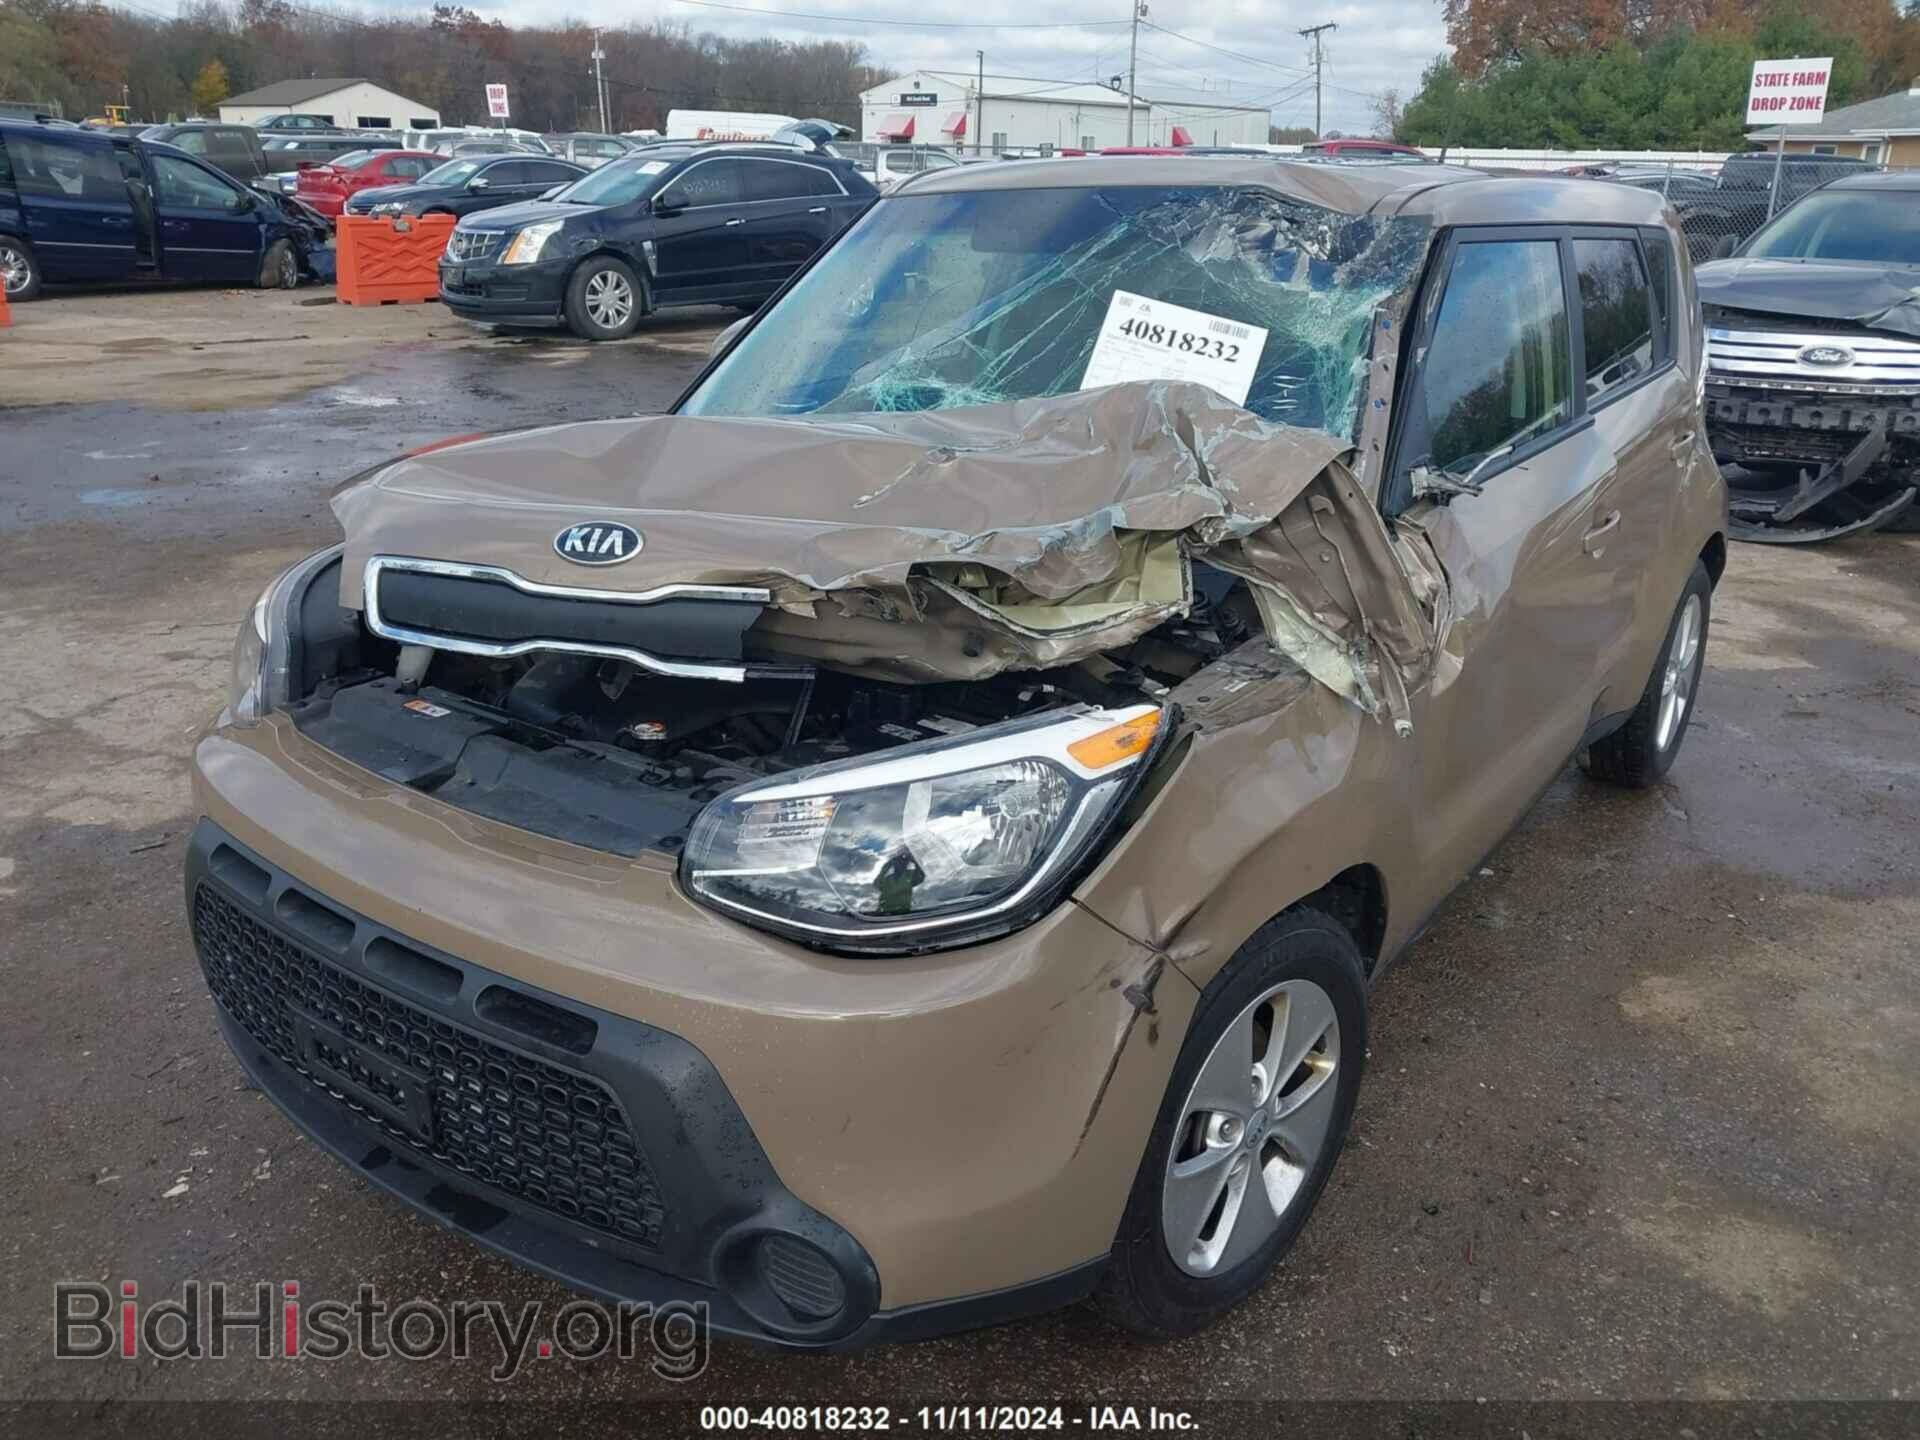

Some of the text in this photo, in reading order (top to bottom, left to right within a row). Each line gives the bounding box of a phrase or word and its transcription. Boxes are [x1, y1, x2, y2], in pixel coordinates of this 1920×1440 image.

[1755, 71, 1827, 87] STATE FARM
[1751, 96, 1822, 111] DROP ZONE
[1119, 316, 1240, 364] 40818232
[1810, 348, 1842, 362] Ford
[563, 527, 624, 556] KIA
